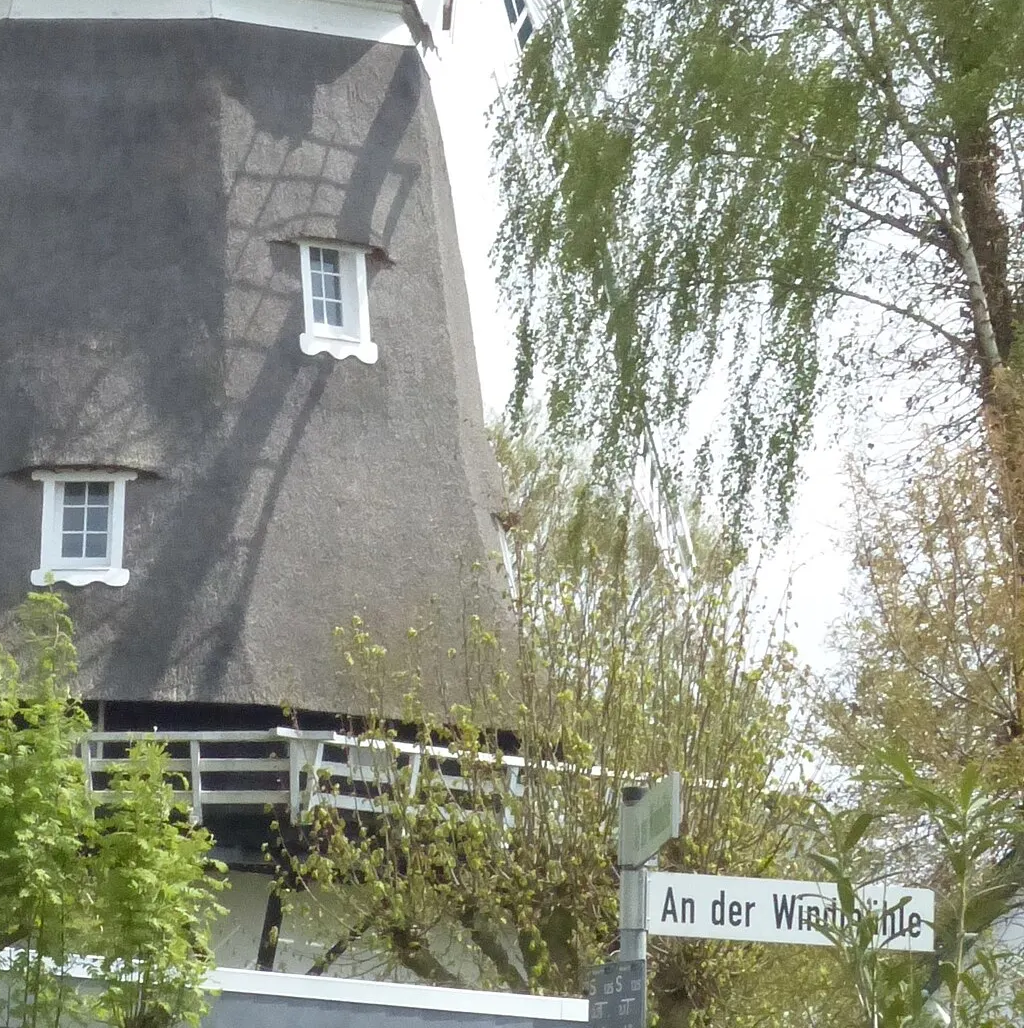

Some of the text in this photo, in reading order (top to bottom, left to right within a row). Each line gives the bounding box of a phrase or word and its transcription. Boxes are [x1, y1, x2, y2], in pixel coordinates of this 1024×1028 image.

[661, 886, 922, 938] An der Windhle
